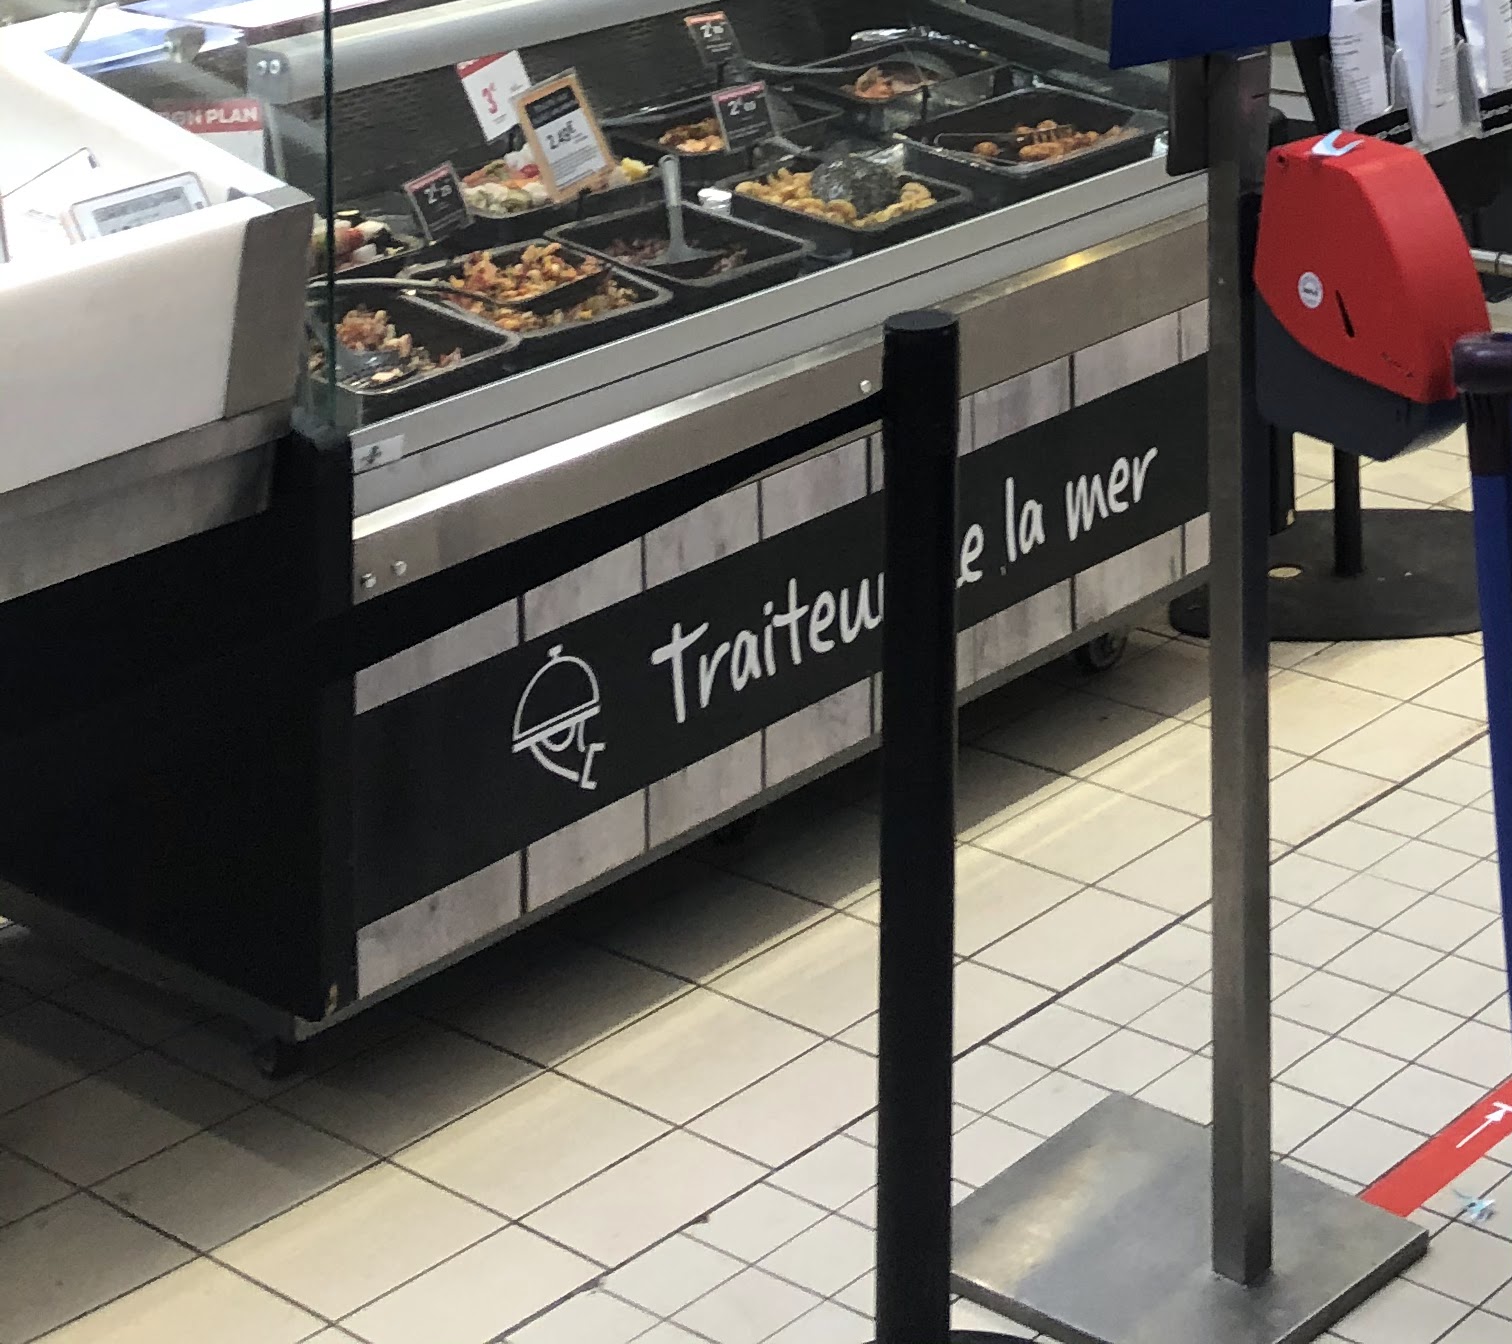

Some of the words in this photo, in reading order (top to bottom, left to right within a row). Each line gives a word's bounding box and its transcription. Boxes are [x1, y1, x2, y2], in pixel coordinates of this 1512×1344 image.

[205, 107, 258, 124] PLAN
[651, 576, 886, 724] Traiteu
[956, 522, 985, 589] e
[1004, 476, 1046, 562] la
[1066, 446, 1158, 543] mer
